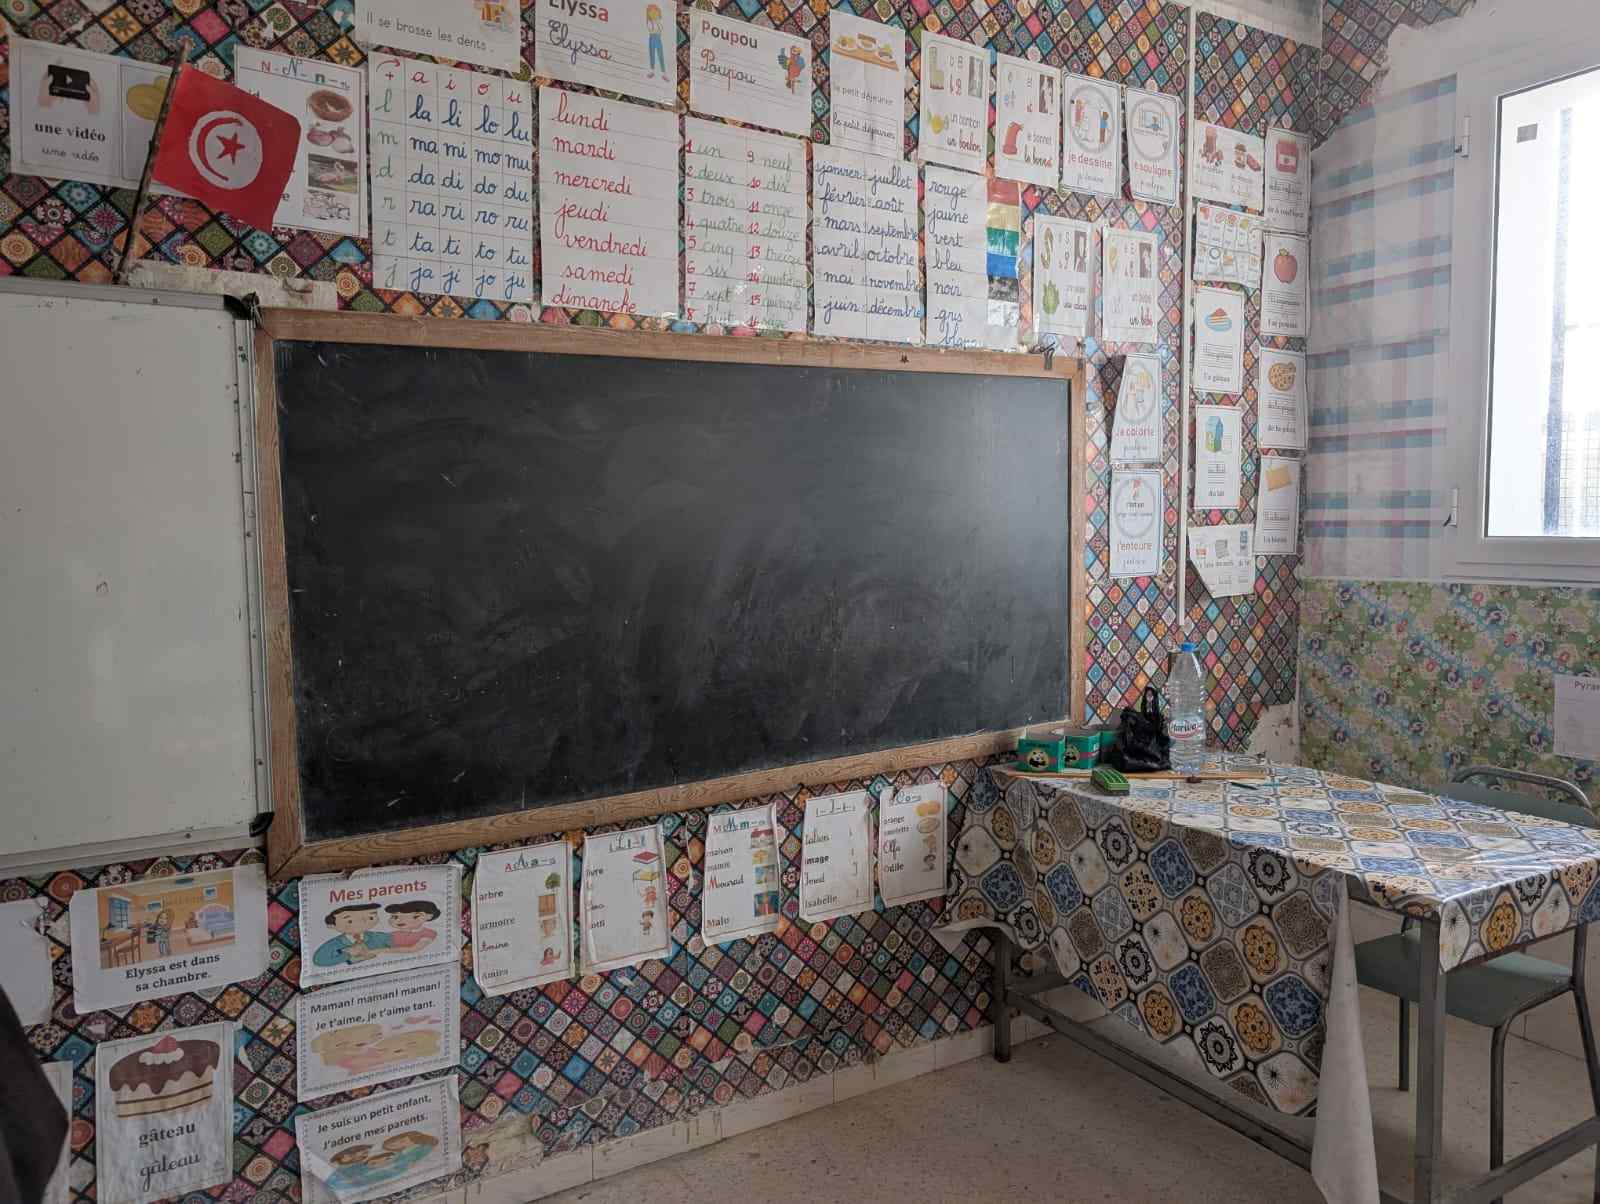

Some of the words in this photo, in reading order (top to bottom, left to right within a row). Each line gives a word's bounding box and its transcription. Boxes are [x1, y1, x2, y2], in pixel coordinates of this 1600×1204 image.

[378, 17, 392, 28] se
[396, 19, 433, 38] brosse
[438, 27, 453, 42] les
[548, 19, 612, 65] Elyssa
[702, 20, 758, 49] Poupou
[700, 48, 756, 91] Poupou
[411, 71, 429, 84] a
[446, 73, 457, 90] i
[477, 83, 491, 96] o
[506, 90, 522, 104] u
[409, 94, 433, 122] la
[441, 99, 463, 127] li
[475, 104, 500, 134] lo
[504, 111, 530, 142] lu
[551, 91, 613, 131] lundi
[35, 123, 63, 135] une
[66, 126, 106, 142] vidéo
[685, 139, 693, 154] 1
[377, 130, 400, 145] m
[409, 135, 440, 154] ma
[443, 139, 468, 160] mi
[476, 148, 501, 166] mo
[506, 153, 531, 172] mu
[552, 136, 617, 161] mardi
[376, 155, 393, 179] d
[407, 164, 436, 186] da
[440, 168, 464, 191] di
[473, 176, 497, 195] do
[503, 181, 529, 203] du
[553, 169, 633, 195] mercredi
[928, 180, 968, 211] rouge
[409, 199, 436, 217] ra
[442, 202, 465, 221] ri
[475, 210, 499, 226] ro
[504, 215, 529, 232] ru
[553, 197, 611, 239] jeudi
[824, 216, 862, 233] mars
[927, 204, 969, 234] jaune
[409, 231, 434, 254] ta
[442, 234, 462, 256] ti
[475, 241, 497, 261] to
[506, 246, 530, 266] tu
[562, 231, 648, 257] vendredi
[933, 232, 963, 248] vert
[560, 263, 635, 286] samedi
[932, 247, 963, 272] bleu
[409, 262, 435, 293] ja
[441, 266, 461, 294] ji
[475, 270, 498, 298] jo
[504, 270, 528, 300] ju
[934, 278, 962, 297] noir
[552, 283, 637, 314] dimanche
[823, 295, 860, 325] juin
[804, 855, 829, 865] image
[329, 889, 363, 903] Mes
[368, 880, 428, 900] parents
[479, 889, 504, 901] arbre
[125, 964, 167, 979] Elyssa
[169, 958, 187, 971] est
[191, 954, 221, 967] dans
[136, 983, 149, 992] sa
[152, 971, 211, 988] chambre.
[310, 997, 354, 1014] Maman!
[357, 990, 399, 1005] maman!
[402, 982, 441, 997] maman!
[315, 1017, 329, 1031] Je
[330, 1013, 365, 1030] t'aime,
[367, 1008, 377, 1020] je
[379, 1004, 411, 1018] t'aime
[412, 1000, 437, 1012] tant.
[318, 1124, 329, 1134] Je
[331, 1117, 352, 1130] suis
[354, 1113, 368, 1124] un
[370, 1103, 396, 1120] petit
[396, 1094, 432, 1111] enfant,
[139, 1123, 196, 1148] gâteau
[323, 1133, 361, 1150] J'adore
[364, 1125, 385, 1138] mes
[387, 1113, 429, 1133] parents.
[140, 1154, 201, 1192] gâteau
